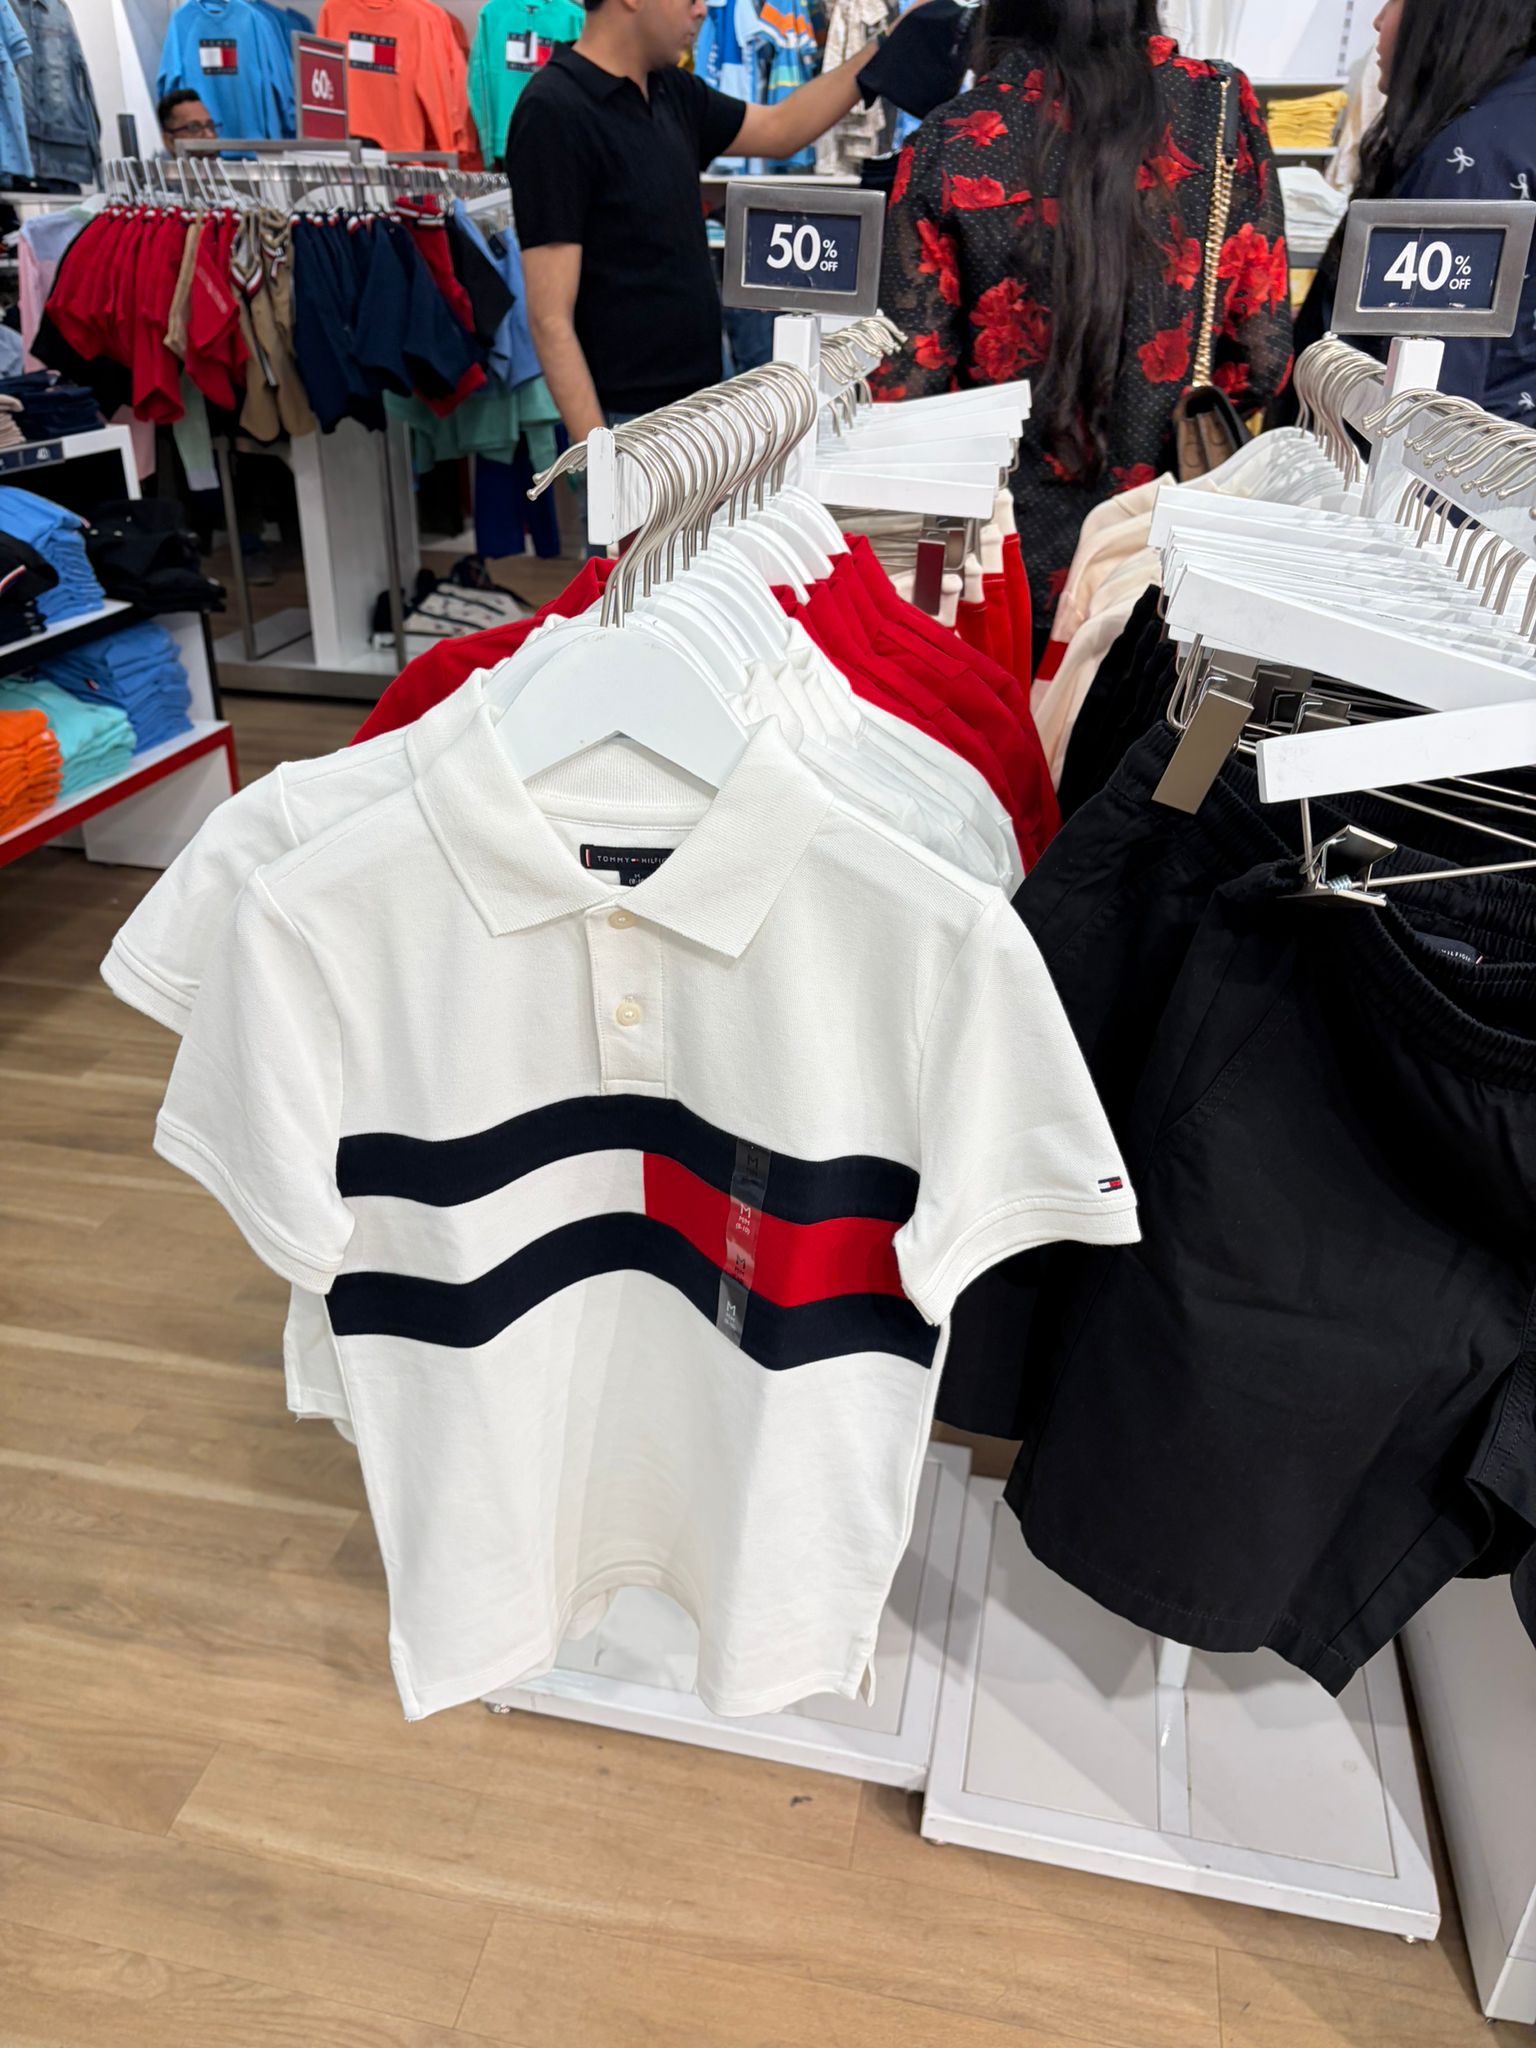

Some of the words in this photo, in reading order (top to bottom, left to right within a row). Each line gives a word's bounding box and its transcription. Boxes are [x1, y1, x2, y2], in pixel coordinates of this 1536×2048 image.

[766, 223, 838, 271] 50%
[820, 261, 838, 272] OFF
[1383, 241, 1472, 291] 40%
[1449, 278, 1471, 290] OFF
[597, 855, 630, 864] TOMMY
[740, 1203, 751, 1218] M
[736, 1253, 746, 1269] M
[726, 1300, 736, 1316] M
